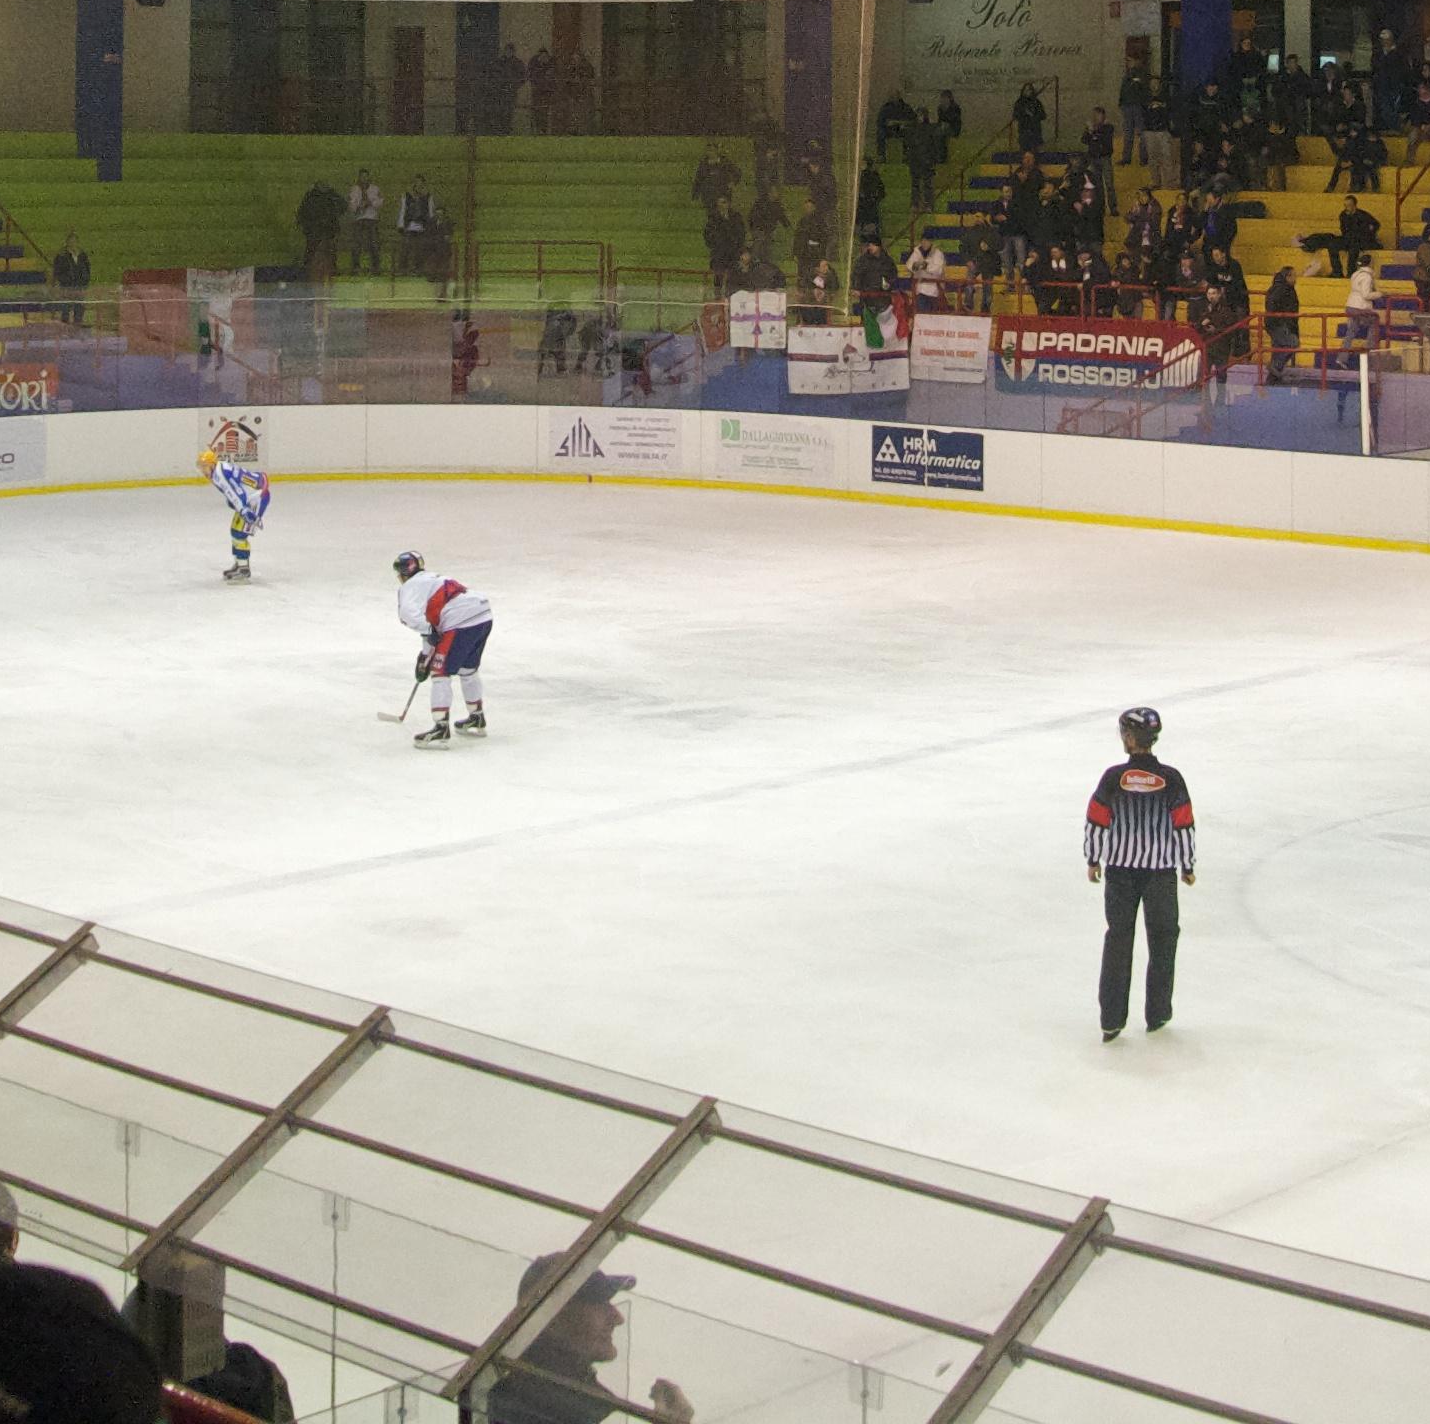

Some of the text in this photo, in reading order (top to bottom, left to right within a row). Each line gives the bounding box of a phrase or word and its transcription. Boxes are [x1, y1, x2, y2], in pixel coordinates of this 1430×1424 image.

[1039, 333, 1163, 357] PADANIA
[903, 437, 937, 452] HRM
[903, 451, 980, 470] informatica
